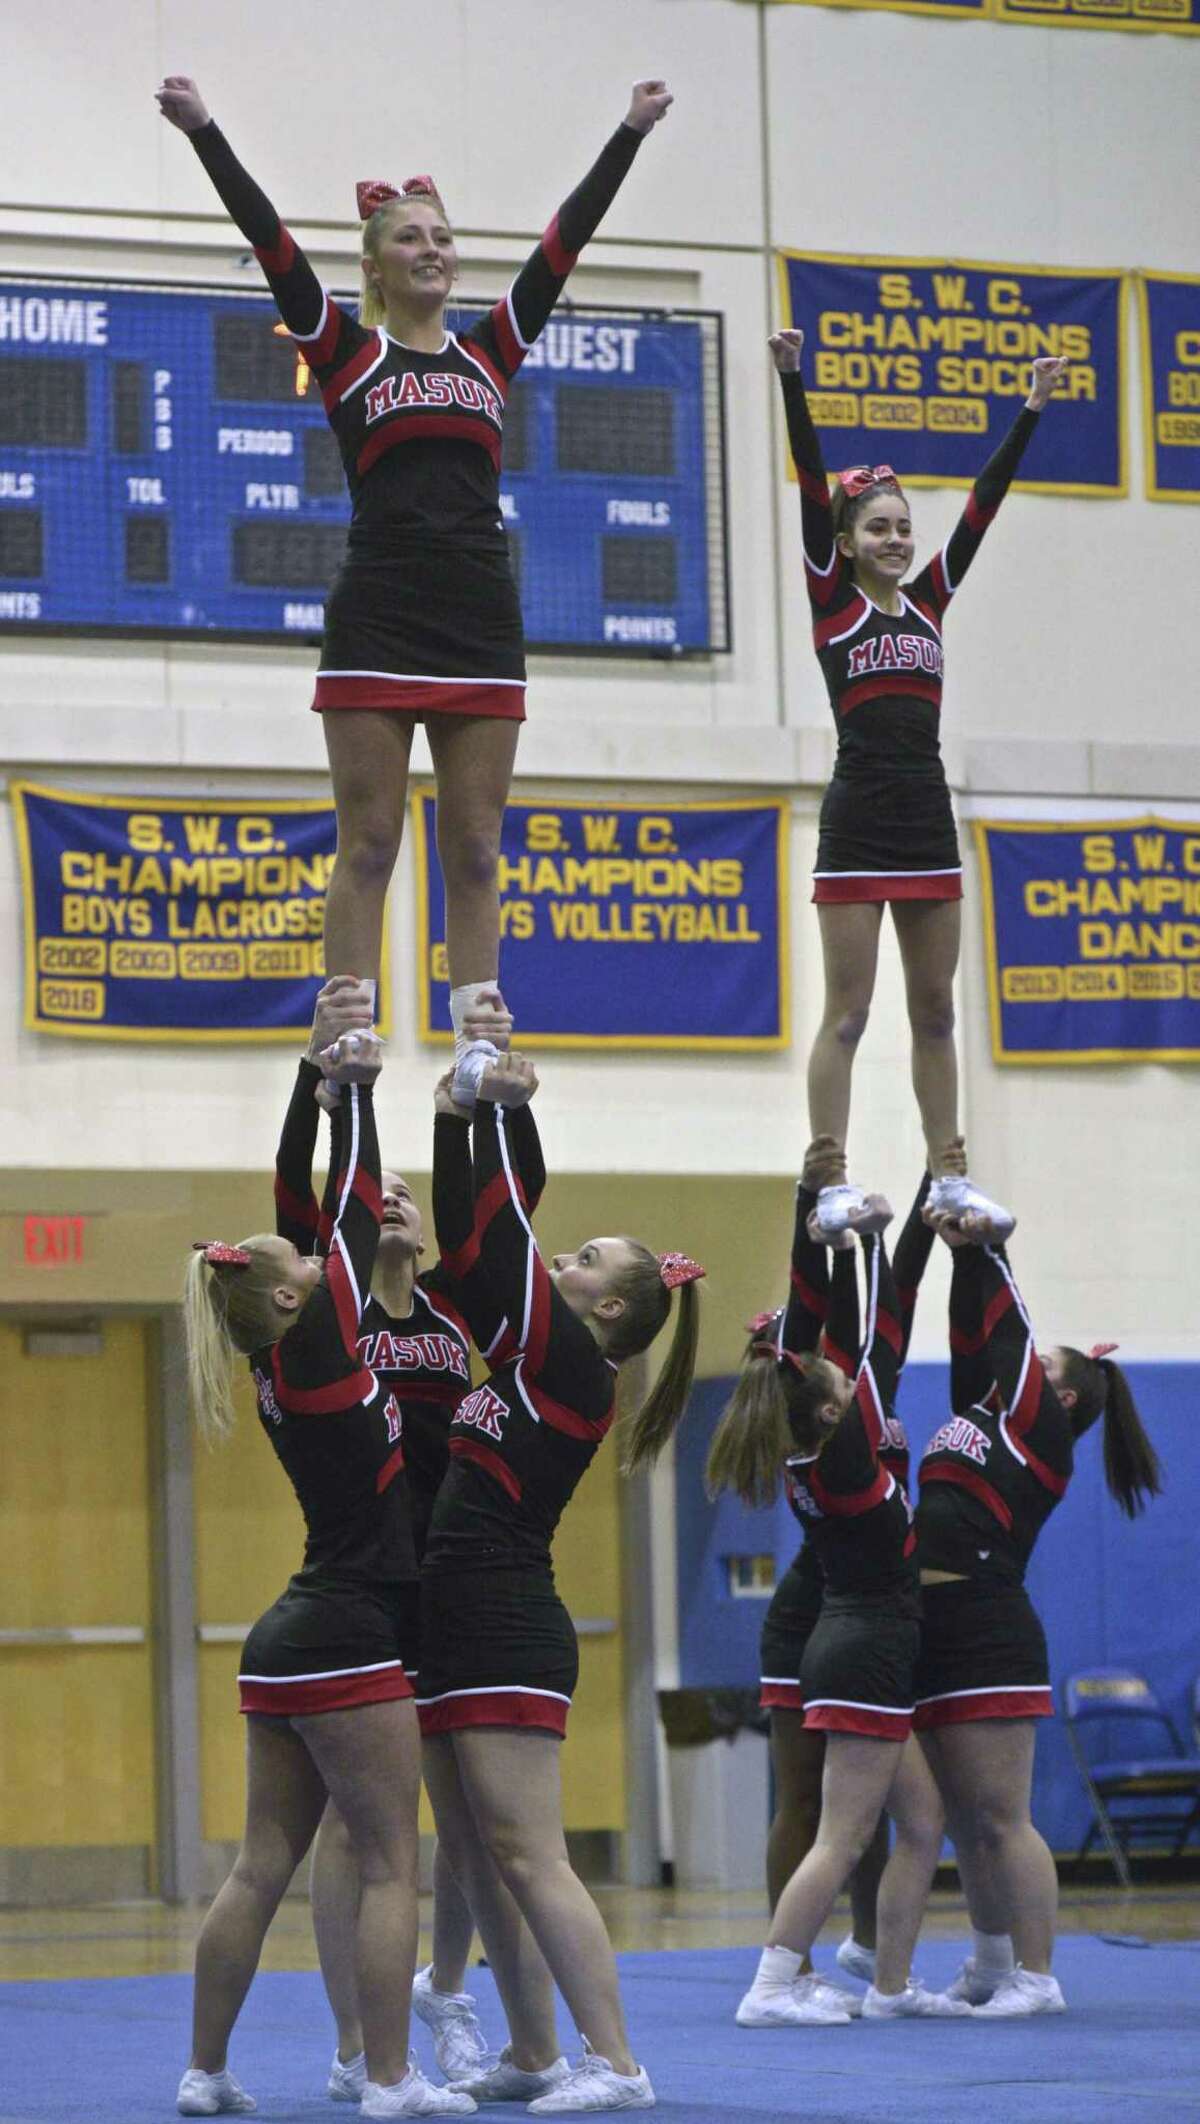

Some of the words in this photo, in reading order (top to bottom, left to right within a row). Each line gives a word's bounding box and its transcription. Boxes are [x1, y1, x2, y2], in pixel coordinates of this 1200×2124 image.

[0, 296, 108, 346] HOME
[818, 311, 1092, 361] CHAMPIONS
[815, 350, 922, 391] BOYS
[366, 372, 504, 431] MASUK
[217, 428, 293, 456] PERIOD
[127, 477, 168, 505] TOL
[245, 482, 298, 510] PLYR
[606, 499, 671, 527] FOULS
[603, 615, 677, 643] POINTS
[62, 895, 153, 935] BOYS
[1024, 877, 1200, 917] CHAMPI
[549, 902, 760, 942] VOLLEYBALL
[43, 945, 99, 970] 2002
[116, 948, 171, 973] 2003
[254, 948, 303, 972] 2011
[24, 1216, 84, 1264] EXIT
[923, 1416, 992, 1466] SUK
